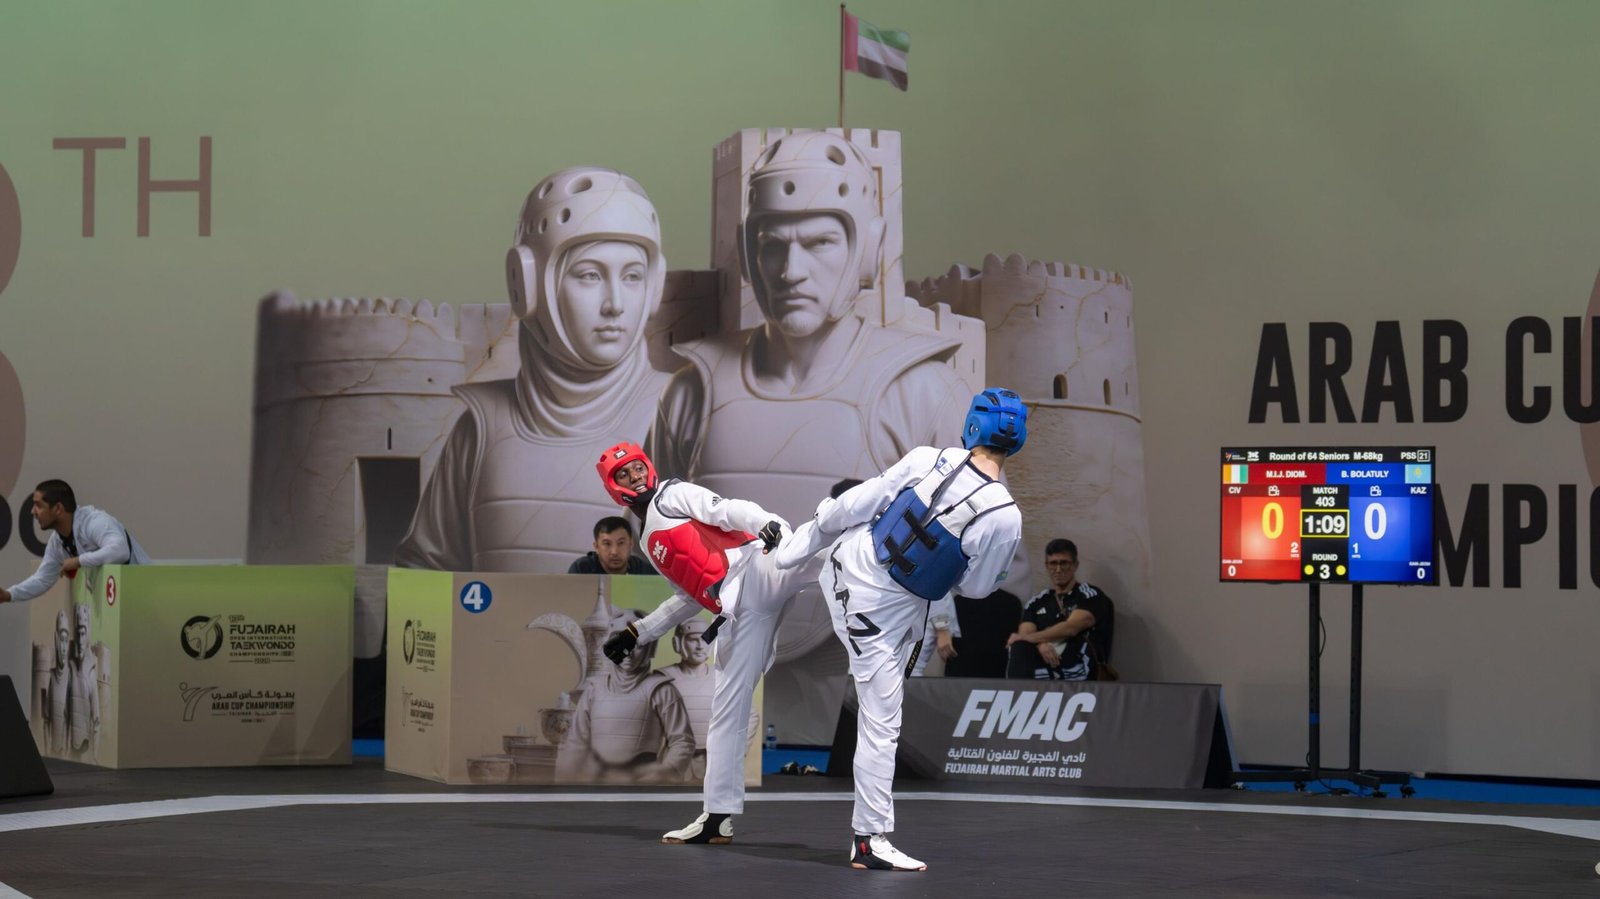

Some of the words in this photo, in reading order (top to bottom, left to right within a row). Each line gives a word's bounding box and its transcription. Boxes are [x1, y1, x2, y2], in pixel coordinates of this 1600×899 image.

[52, 136, 213, 238] TH
[1248, 319, 1469, 424] ARAB
[1269, 452, 1296, 461] Round
[1297, 452, 1307, 461] of
[1307, 452, 1318, 461] 64
[1319, 452, 1350, 461] Seniors
[1353, 452, 1383, 462] M-68kg
[1400, 452, 1417, 460] PSS
[1286, 470, 1308, 478] DIOM.
[1341, 470, 1349, 478] B.
[1350, 470, 1390, 478] BOLATULY
[1228, 486, 1242, 494] CIV
[1315, 497, 1335, 507] 403
[1262, 502, 1284, 539] 0
[1304, 515, 1346, 534] 1:09
[1364, 502, 1387, 540] 0
[1436, 484, 1600, 590] MPI
[1290, 542, 1299, 553] 2
[1352, 542, 1359, 554] 1
[1312, 553, 1338, 561] ROUND
[1228, 565, 1237, 577] 0
[1319, 564, 1330, 579] 3
[1416, 567, 1426, 579] 0
[463, 583, 484, 610] 4
[229, 624, 296, 635] FUJAIRAH
[230, 641, 296, 650] TAEKWONDO
[952, 689, 1097, 742] FMAC
[947, 747, 985, 761] القتالية
[986, 749, 1020, 762] للفنون
[1022, 750, 1059, 764] الفجيرة
[1062, 751, 1086, 765] نادي
[945, 762, 989, 775] FUJAIRAH
[990, 764, 1030, 777] MARTIAL
[1032, 765, 1056, 778] ARTS
[1058, 766, 1082, 779] CLUB
